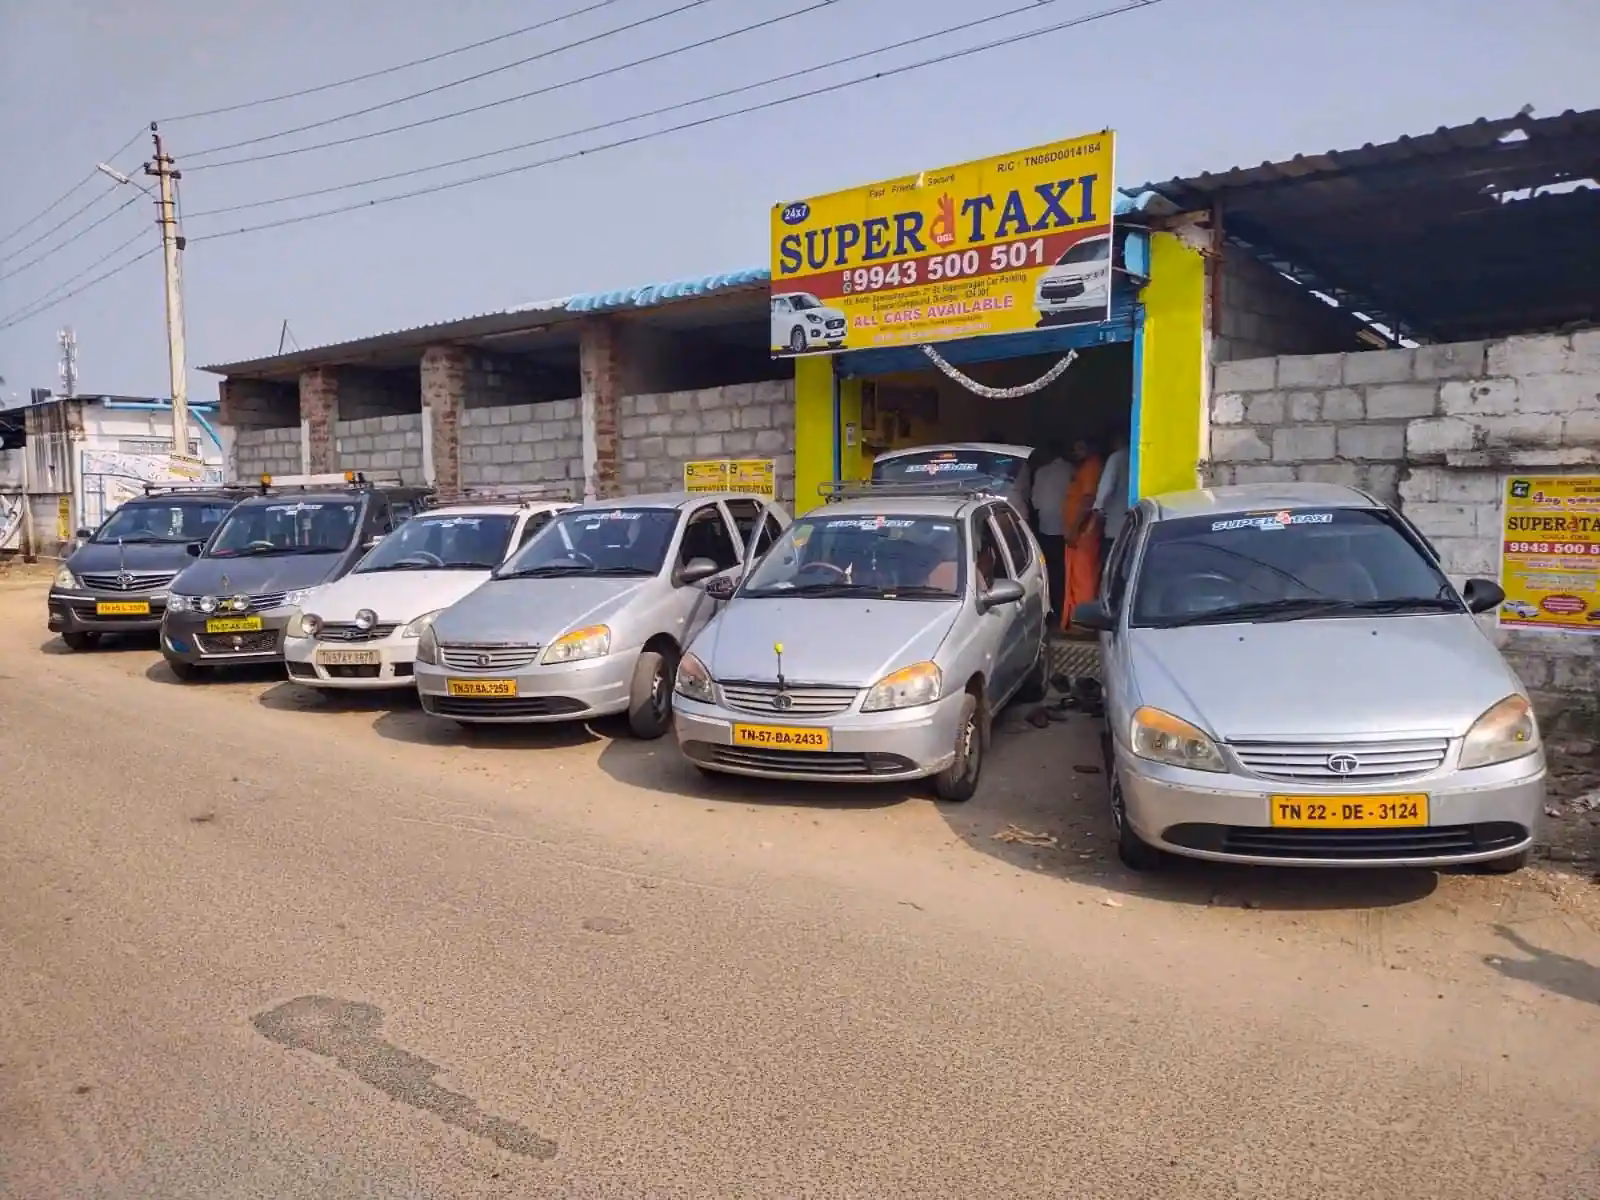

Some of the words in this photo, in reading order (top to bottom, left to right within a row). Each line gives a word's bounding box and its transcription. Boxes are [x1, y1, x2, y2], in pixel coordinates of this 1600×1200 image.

[784, 205, 806, 220] 24x7
[780, 211, 927, 274] SUPER
[961, 174, 1098, 242] TAXI
[854, 260, 917, 291] 9943
[927, 250, 979, 280] 500
[990, 238, 1044, 270] 501
[854, 316, 879, 328] ALL
[884, 308, 922, 323] CARS
[928, 296, 1013, 318] AVAILABLE
[1212, 516, 1276, 531] SUPER
[1291, 513, 1333, 524] TAXI
[1508, 516, 1567, 531] SUPER
[1510, 542, 1549, 552] 9943
[1554, 543, 1585, 554] 500
[740, 728, 823, 745] TN-57-BA-2433
[1279, 804, 1301, 821] TN
[1307, 804, 1326, 820] 22
[1342, 804, 1363, 820] DE
[1379, 803, 1418, 820] 3124
